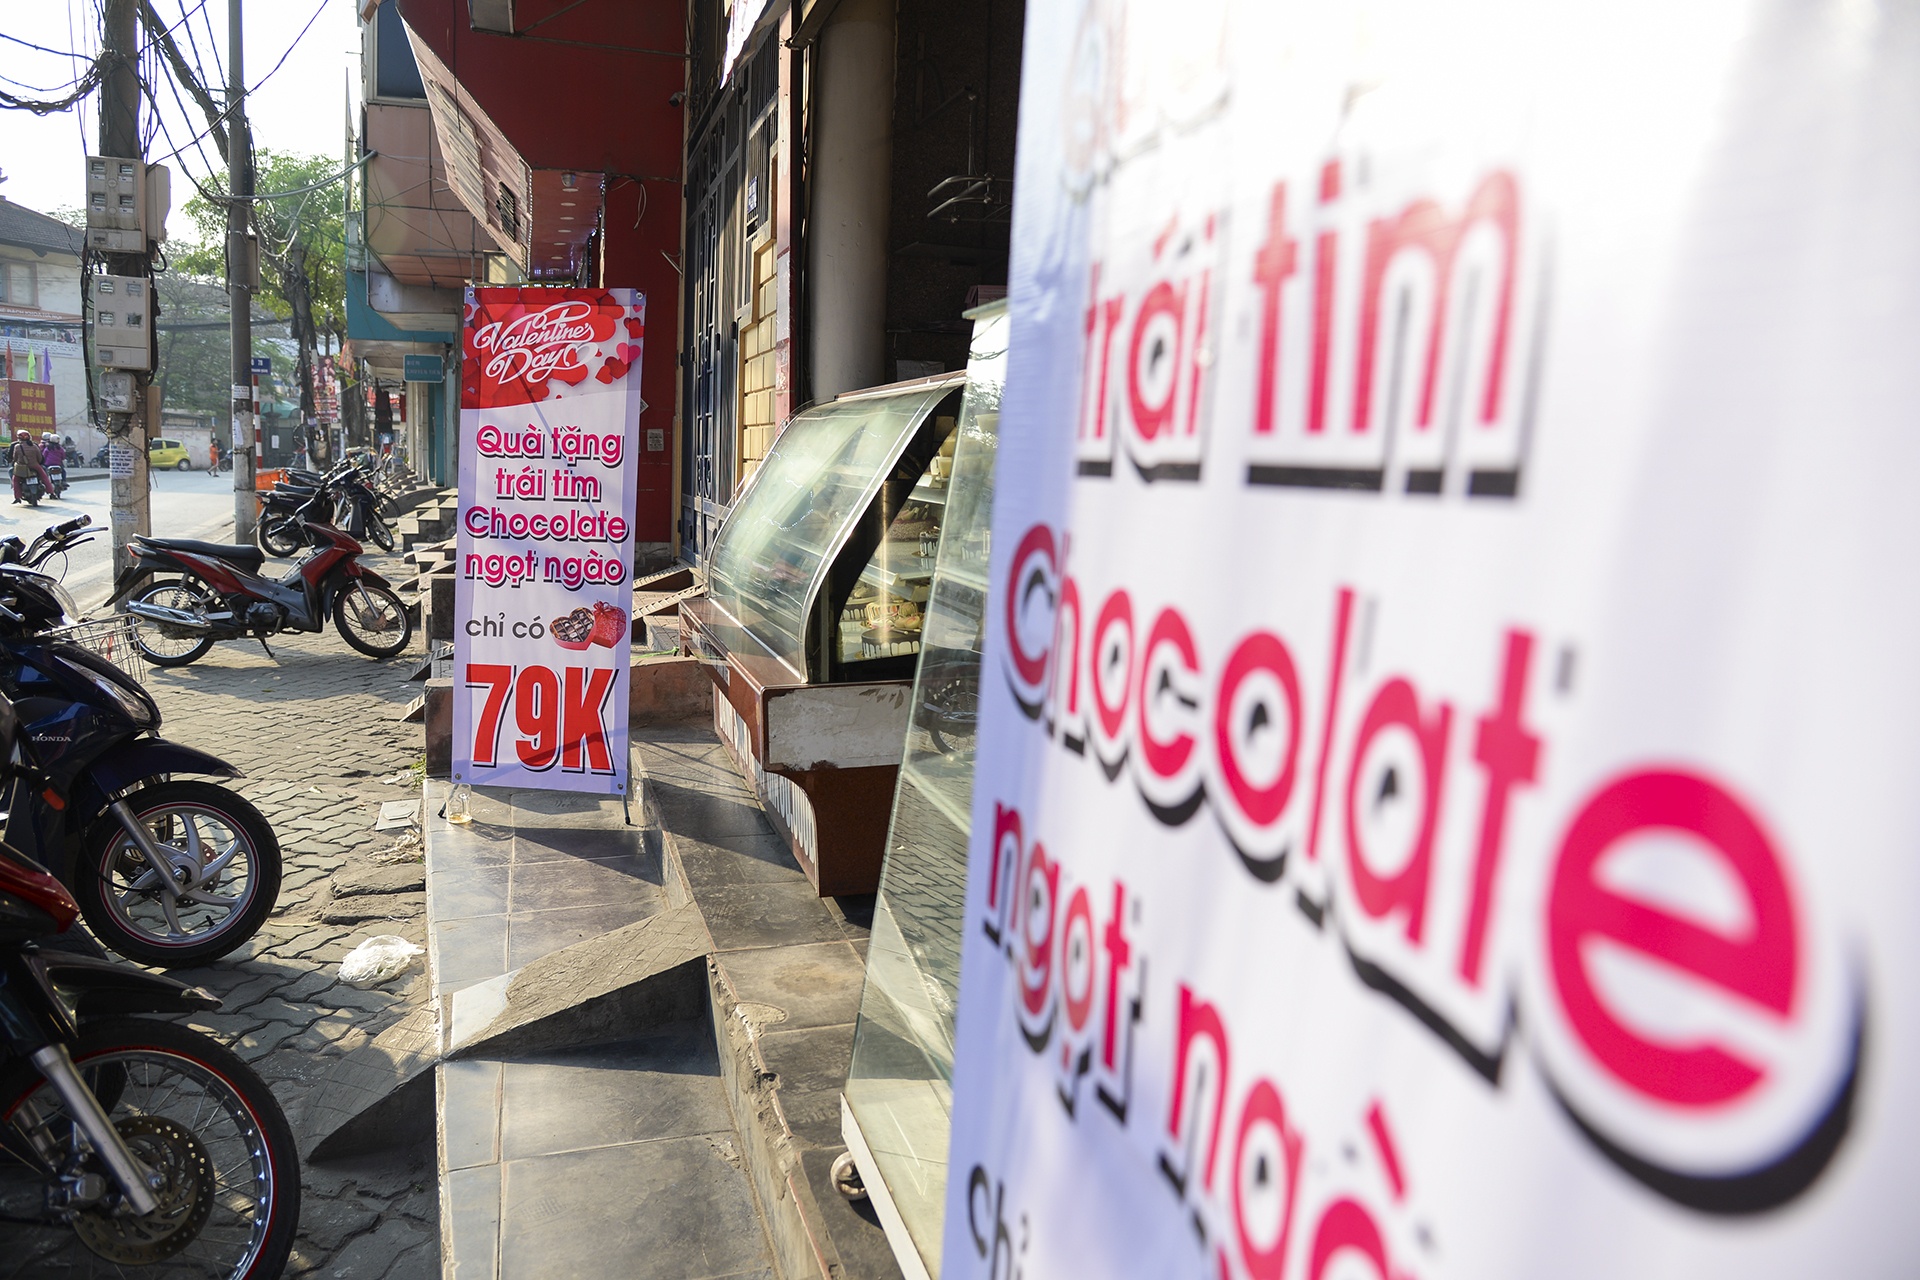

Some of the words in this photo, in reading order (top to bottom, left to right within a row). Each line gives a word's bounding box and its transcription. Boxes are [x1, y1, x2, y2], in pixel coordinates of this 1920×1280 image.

[1248, 158, 1530, 470] tim
[485, 341, 599, 385] Day
[476, 423, 544, 458] Quà
[551, 425, 623, 468] tặng
[495, 466, 545, 499] trái
[553, 469, 601, 501] tim
[465, 505, 629, 541] Chocolate
[465, 550, 538, 587] ngọt
[544, 549, 626, 590] ngào
[465, 612, 506, 638] chỉ
[512, 615, 545, 640] có
[465, 663, 617, 773] 79K
[1005, 522, 1830, 1170] Chocolate
[985, 800, 1138, 1105] ngọt
